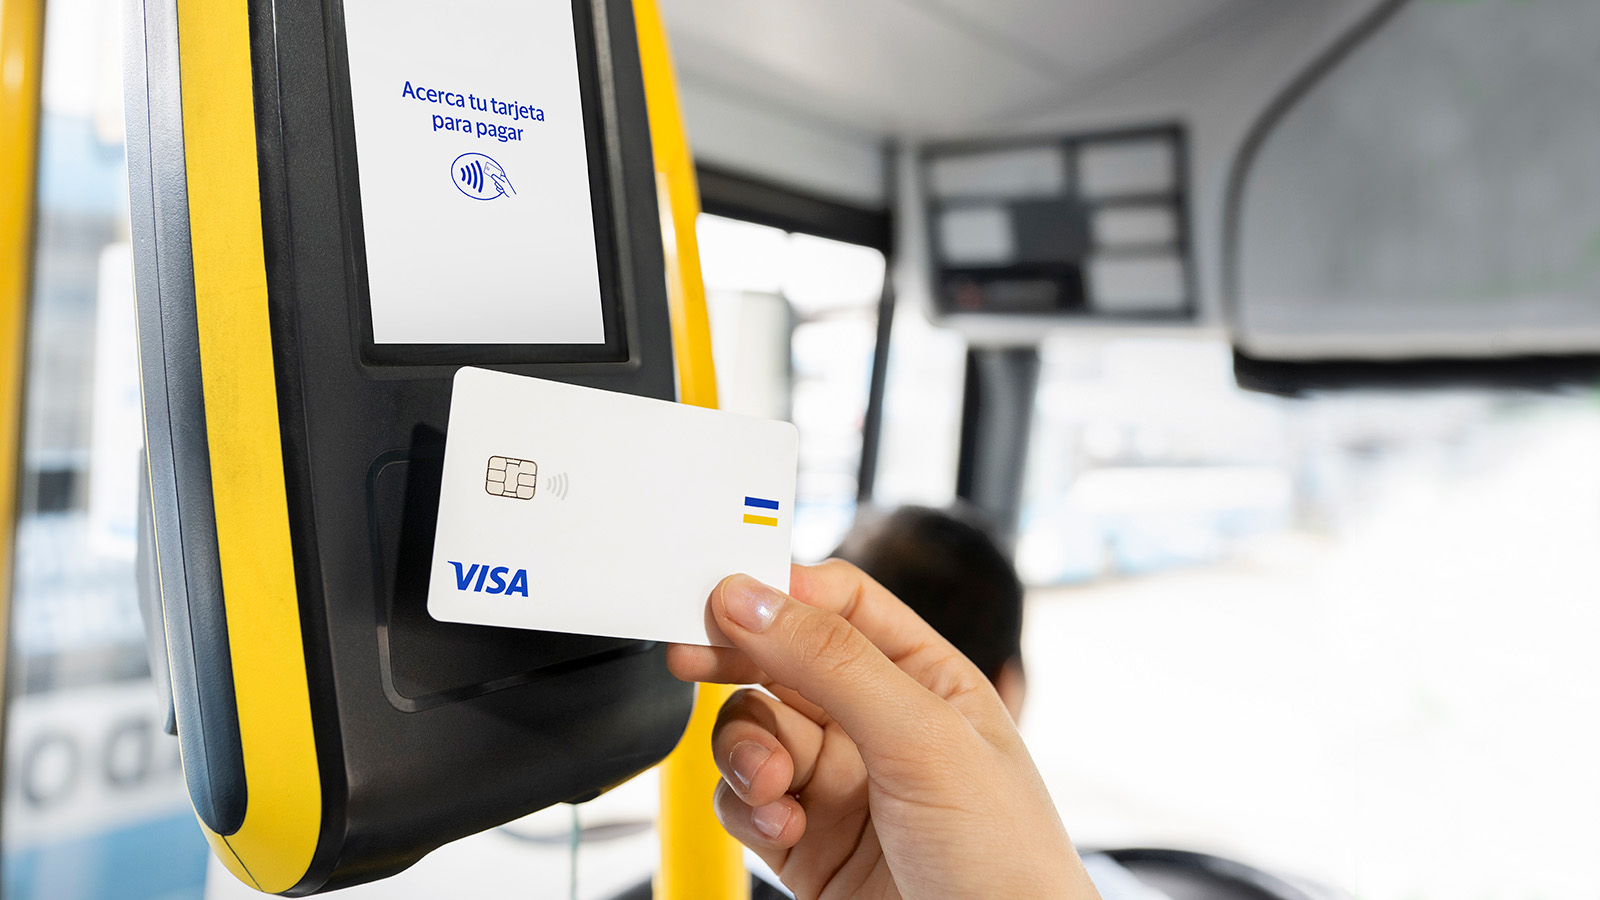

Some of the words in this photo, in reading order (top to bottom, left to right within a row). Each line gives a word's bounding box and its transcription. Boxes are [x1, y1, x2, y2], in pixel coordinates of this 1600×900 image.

[402, 80, 465, 108] Acerca
[468, 93, 488, 112] tu
[490, 97, 545, 122] tarjeta
[432, 114, 472, 132] para
[476, 121, 524, 143] pagar
[447, 560, 529, 598] VISA
